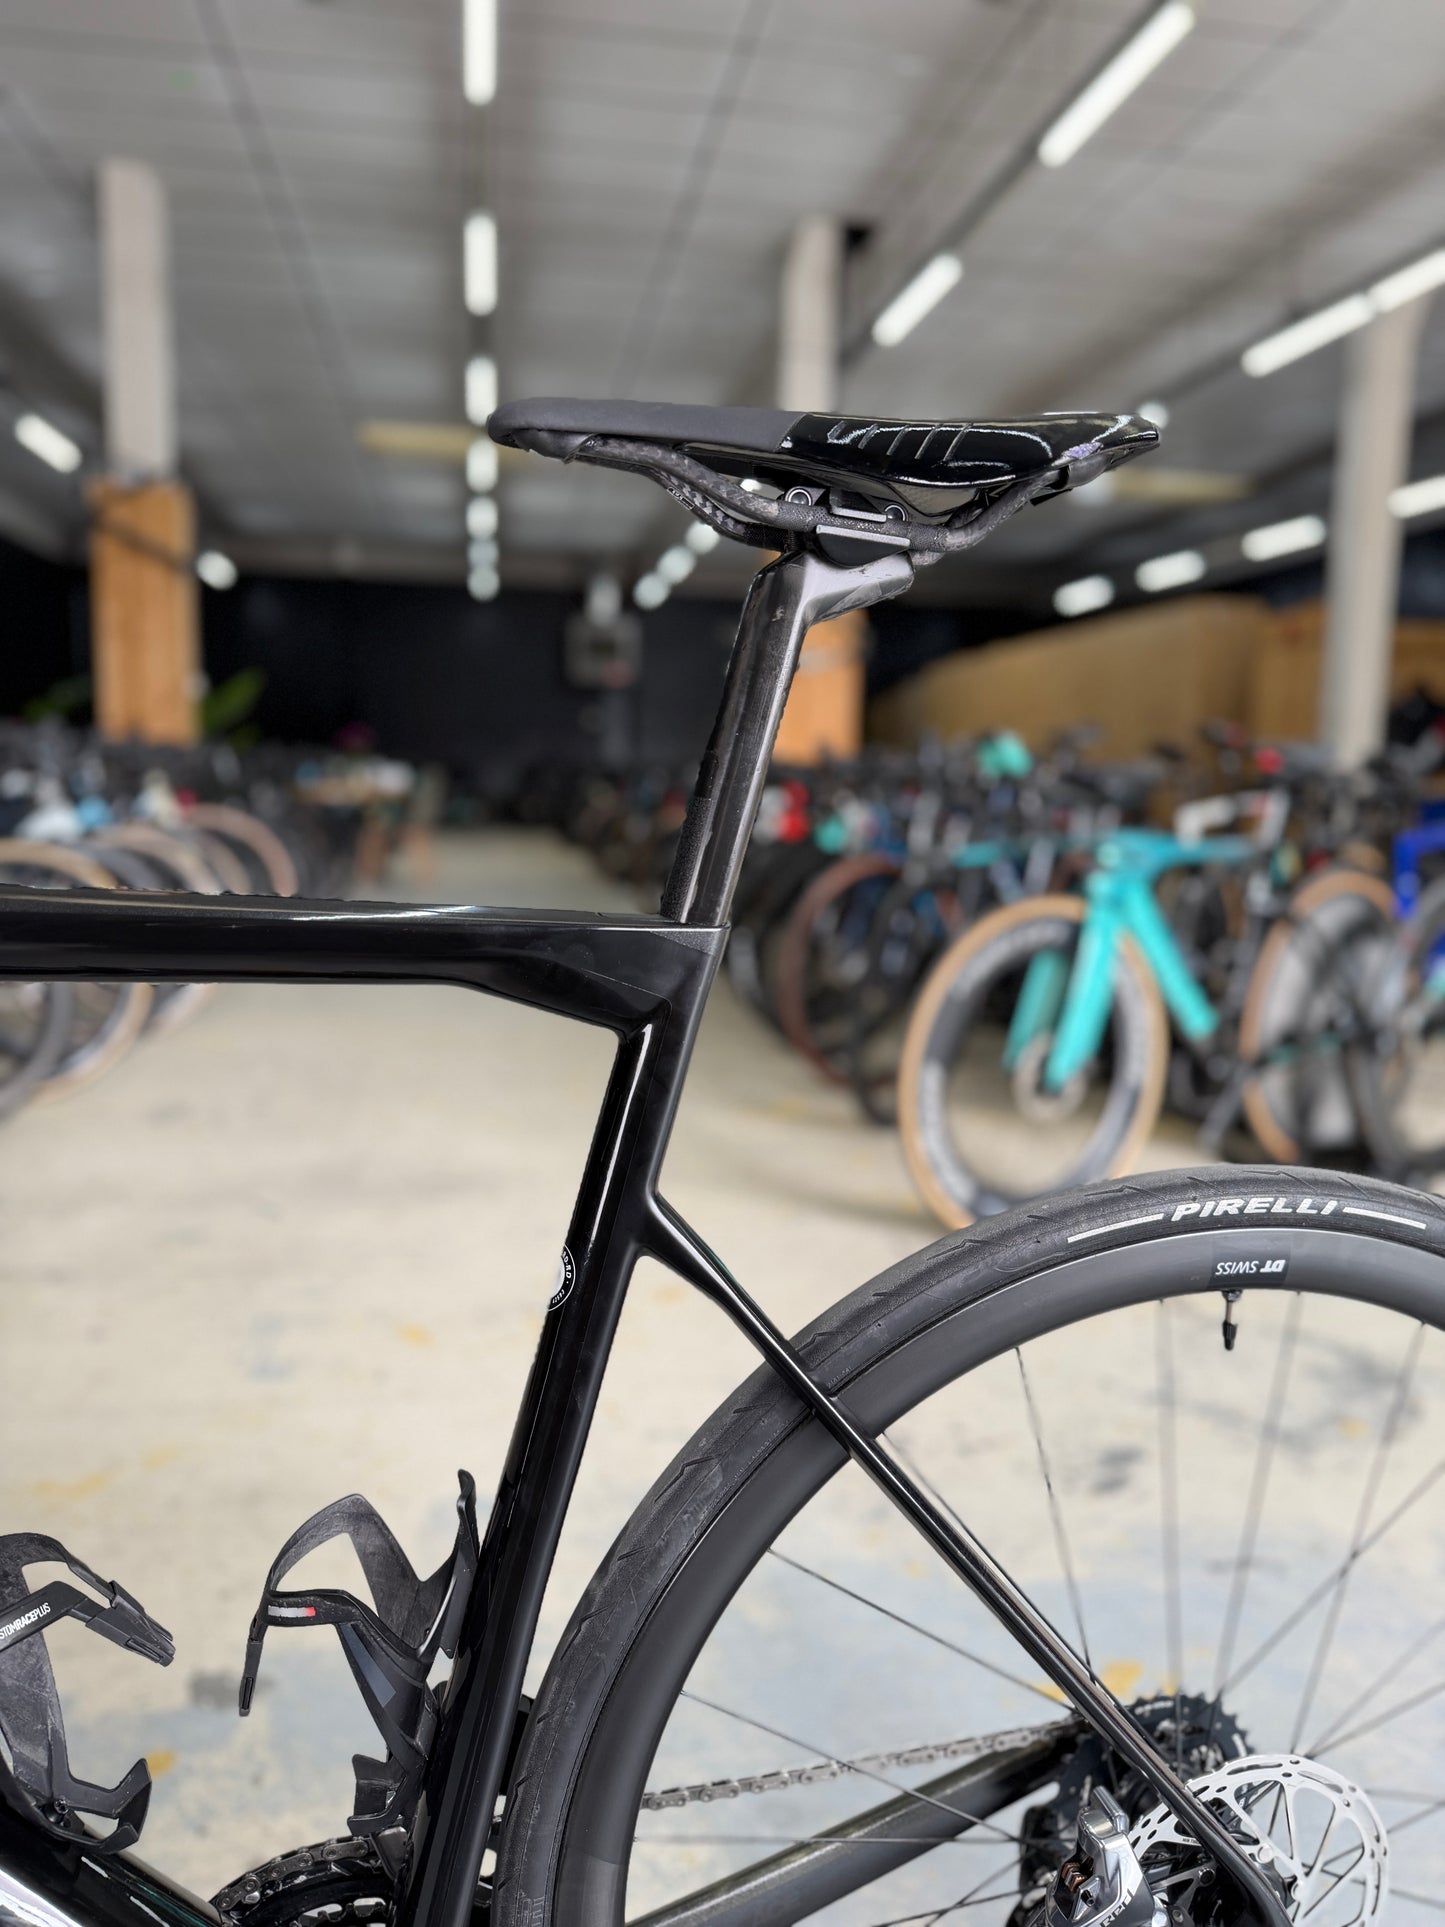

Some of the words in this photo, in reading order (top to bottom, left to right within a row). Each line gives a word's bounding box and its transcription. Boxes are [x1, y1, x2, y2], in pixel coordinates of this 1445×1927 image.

[1171, 1198, 1338, 1221] PIRELLI
[1215, 1261, 1259, 1275] SWISS
[1260, 1260, 1286, 1273] DT
